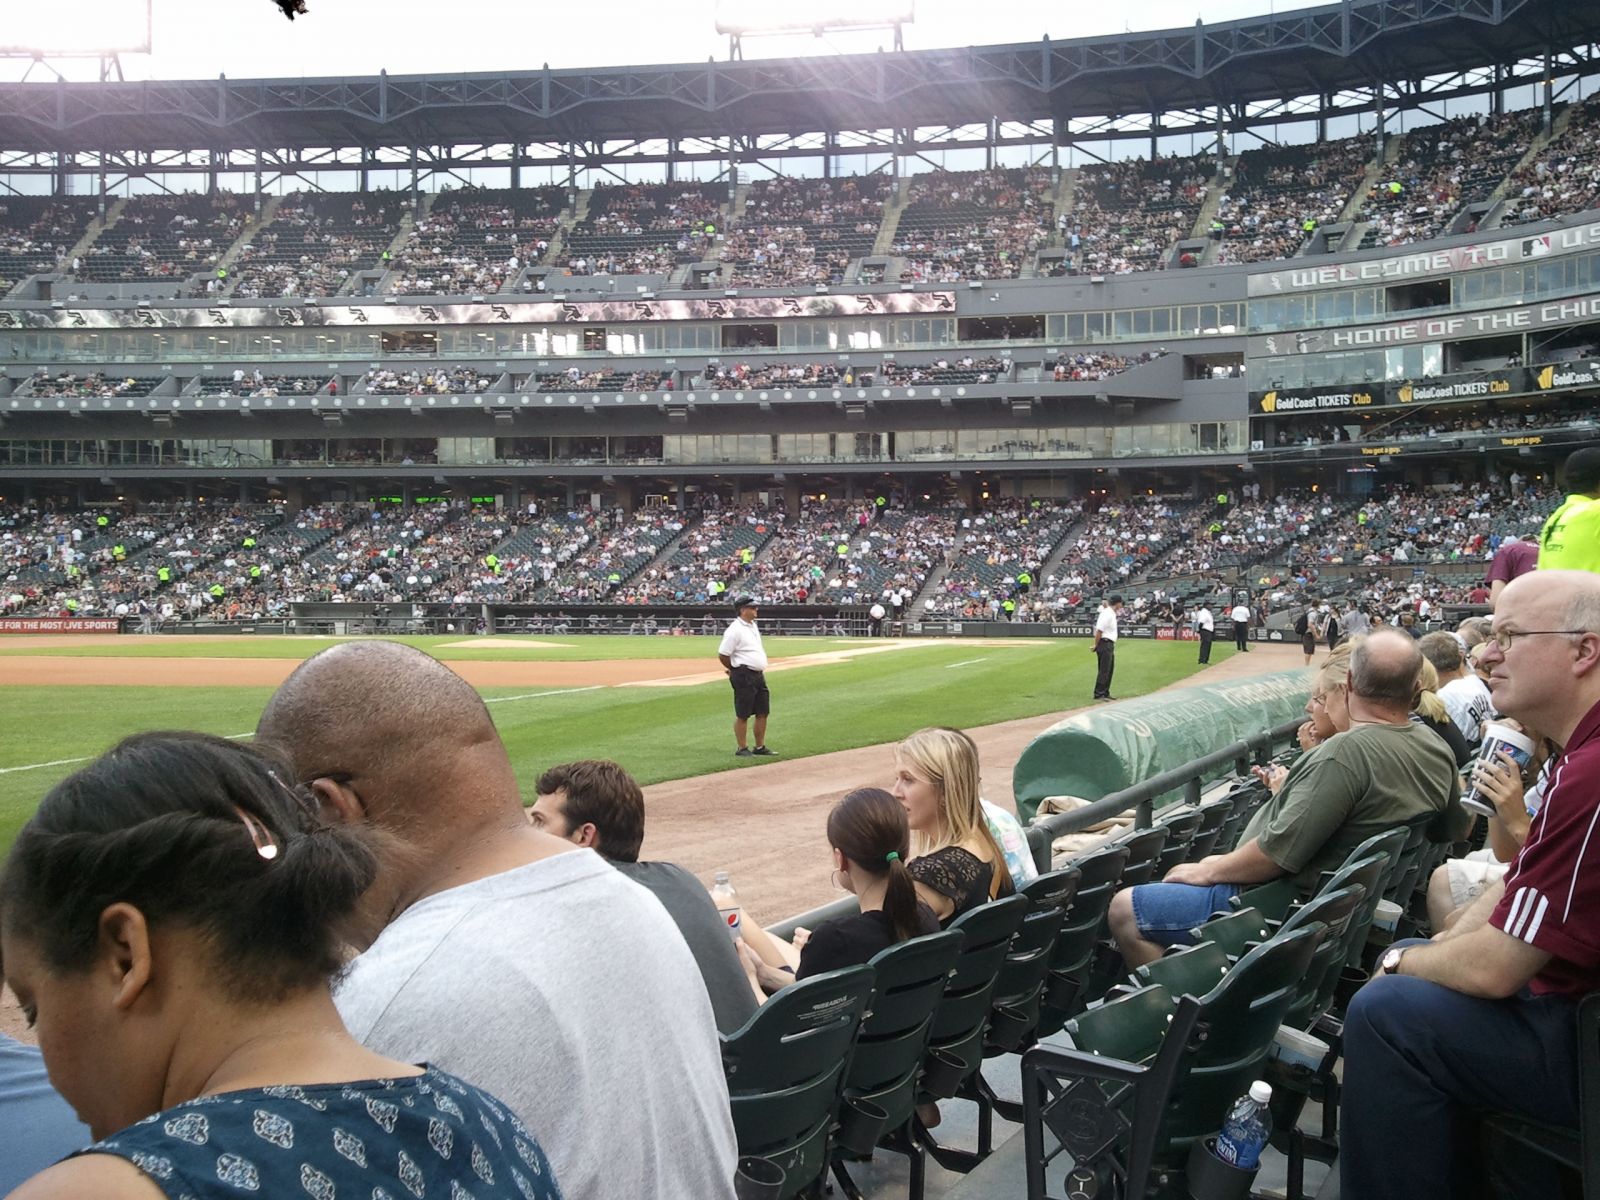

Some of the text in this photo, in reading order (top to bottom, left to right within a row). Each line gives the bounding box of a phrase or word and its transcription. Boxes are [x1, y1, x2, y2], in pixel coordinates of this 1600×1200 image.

[1292, 254, 1451, 287] WELCOME
[1465, 245, 1508, 264] TO
[1334, 325, 1418, 346] HOME
[1427, 318, 1464, 336] OF
[1472, 310, 1531, 330] THE
[1490, 380, 1509, 393] Club
[1352, 393, 1371, 405] Club
[5, 621, 21, 629] FOR
[23, 621, 38, 629] THE
[40, 621, 62, 629] MOST
[64, 621, 82, 629] LIVE
[84, 621, 118, 629] SPORTS
[1052, 627, 1092, 635] UNITED
